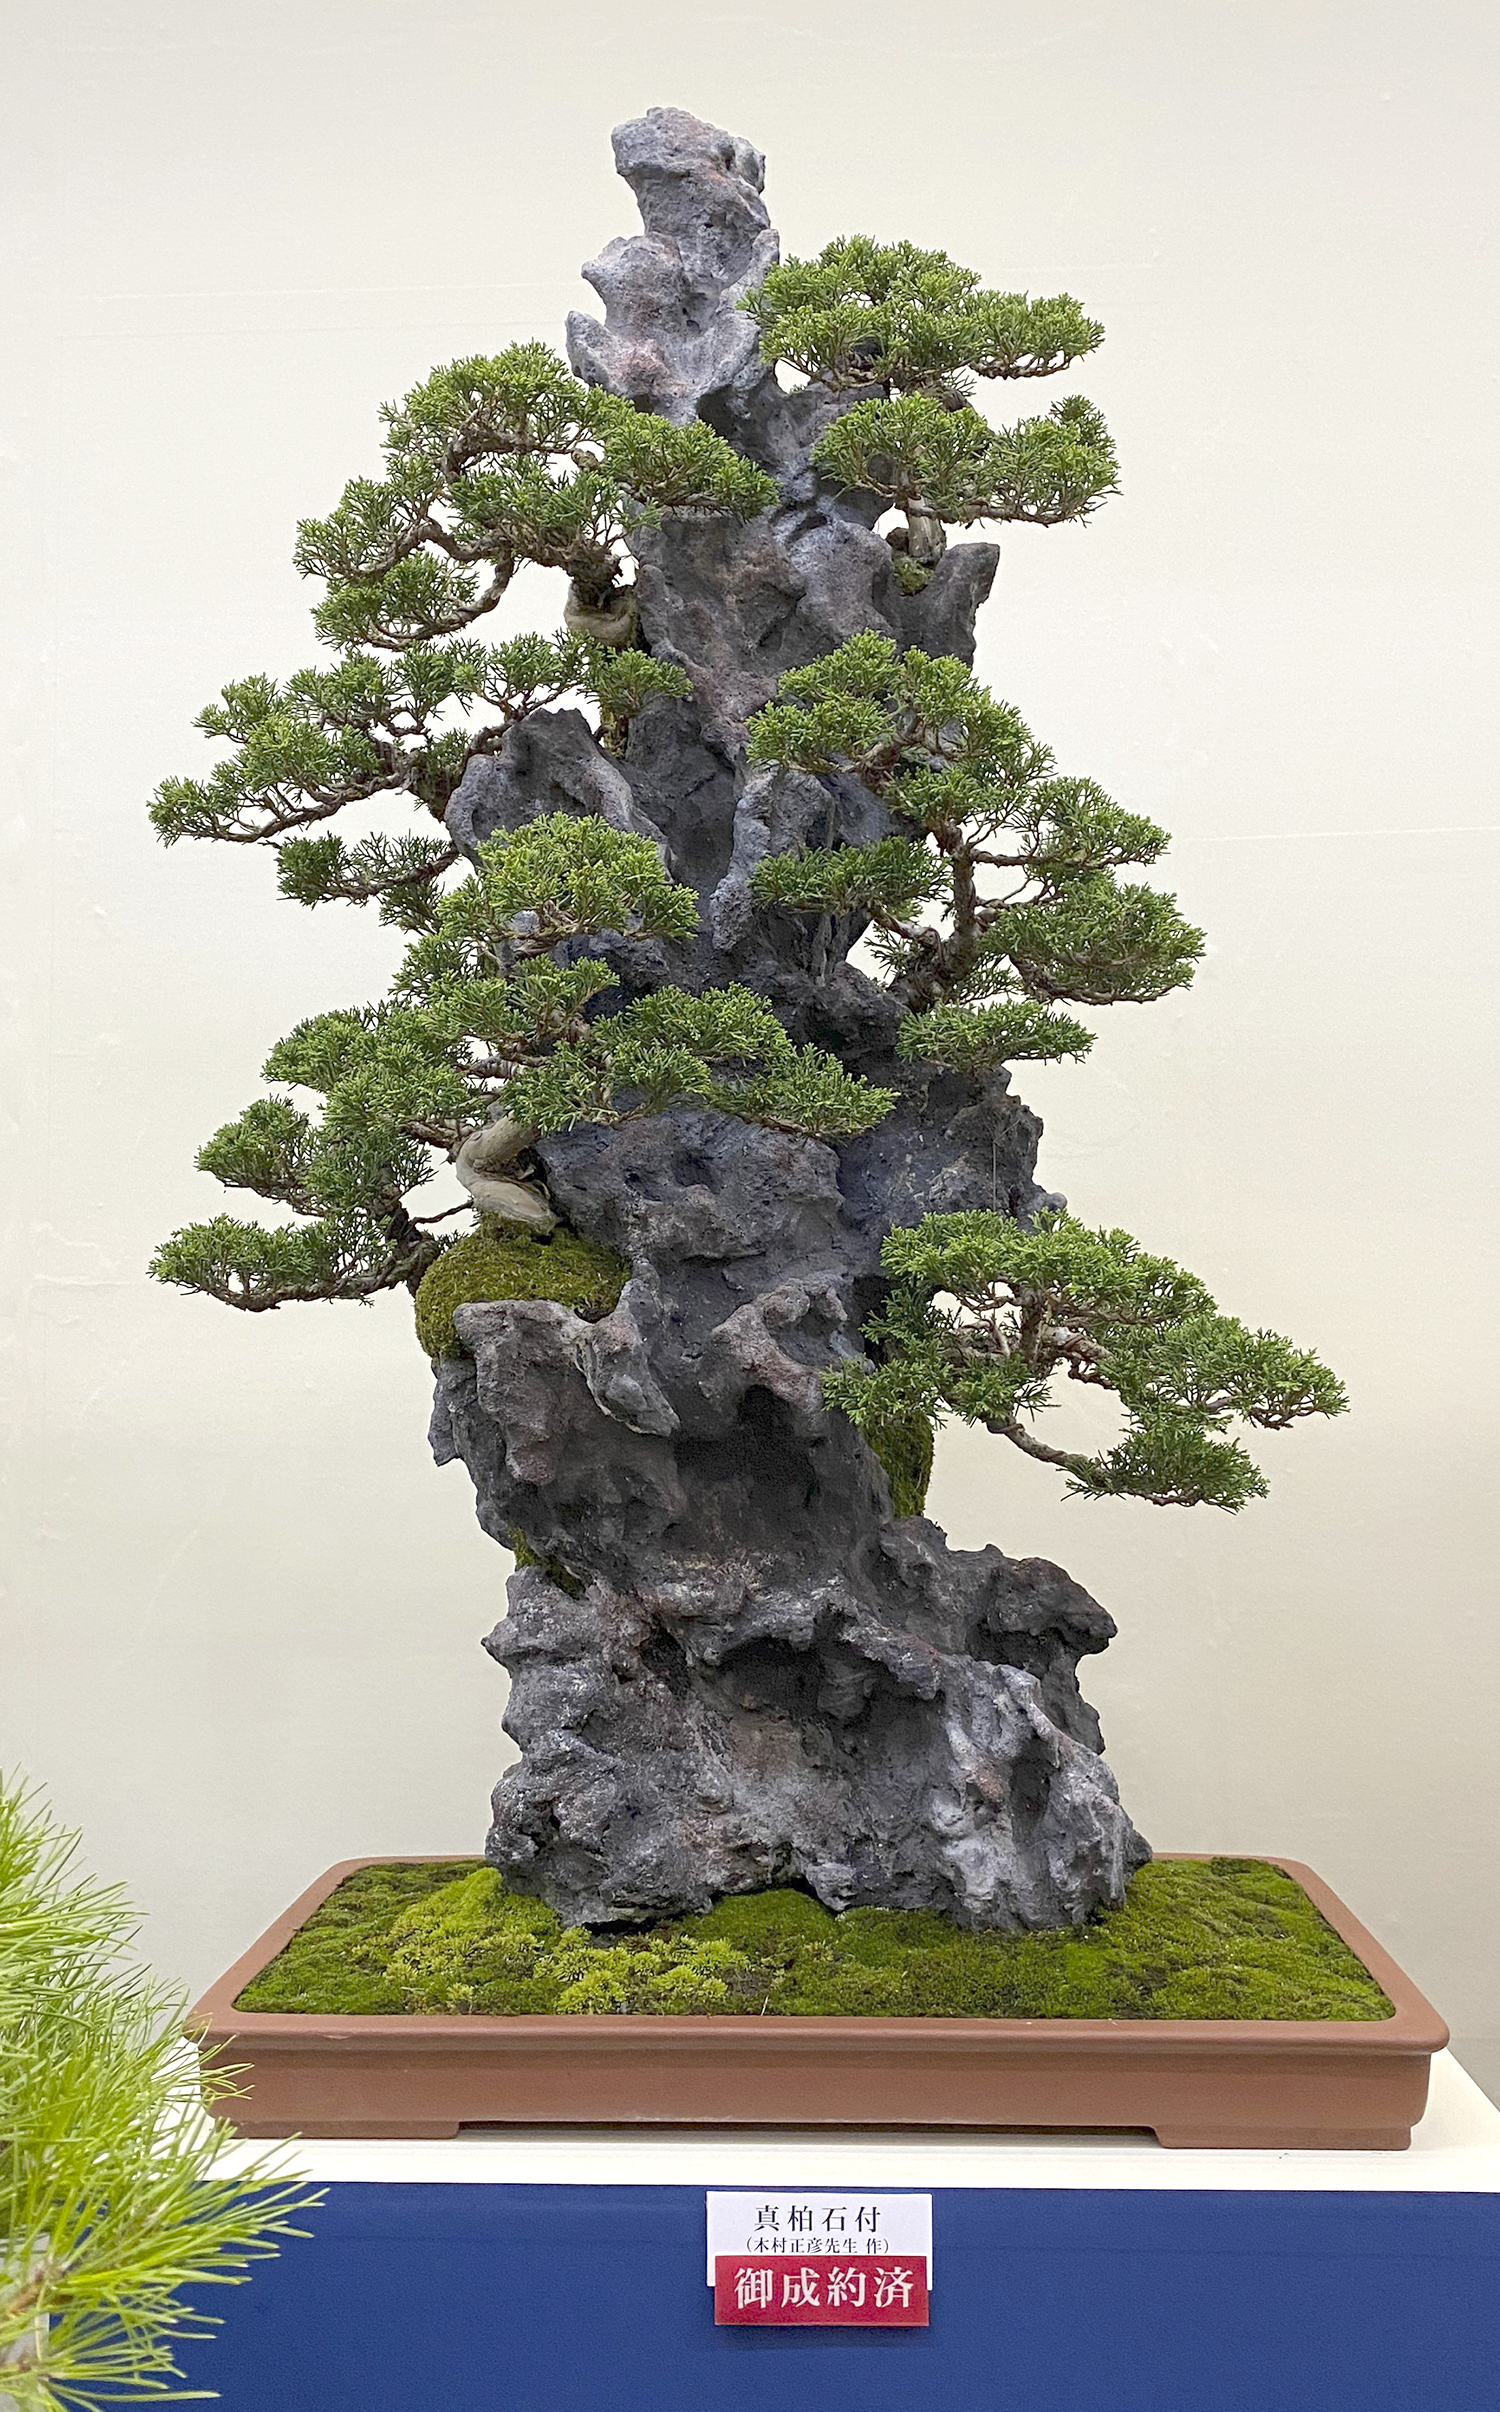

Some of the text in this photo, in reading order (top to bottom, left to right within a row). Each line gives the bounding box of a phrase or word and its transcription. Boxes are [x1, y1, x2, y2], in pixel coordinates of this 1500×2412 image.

[754, 2205, 881, 2232] 真柏石付
[734, 2266, 914, 2309] 御成約済
